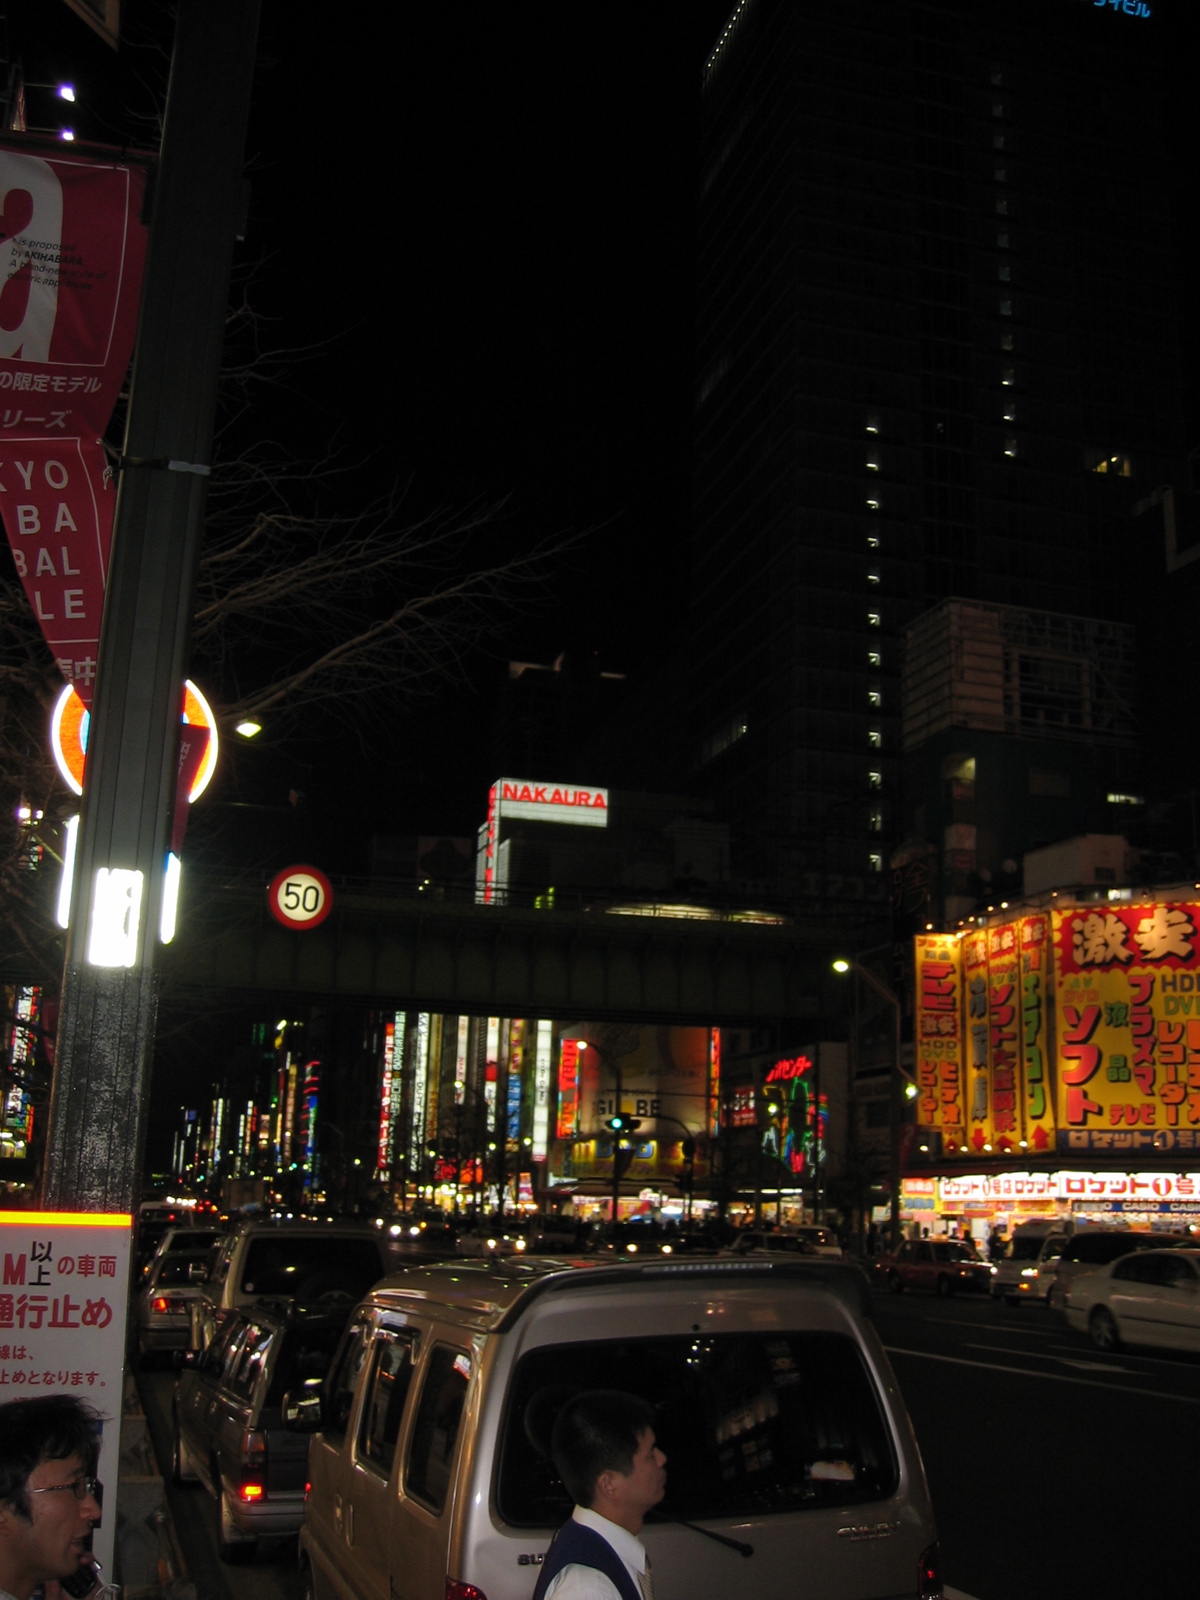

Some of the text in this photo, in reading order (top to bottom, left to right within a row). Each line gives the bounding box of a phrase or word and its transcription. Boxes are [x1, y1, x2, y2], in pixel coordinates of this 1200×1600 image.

[9, 259, 17, 267] A
[11, 248, 83, 265] by AKIHABARA
[0, 409, 72, 429] リーズ
[502, 783, 608, 810] NAKAURA
[284, 882, 320, 913] 50
[1071, 907, 1196, 967] 激安
[1161, 974, 1200, 993] HD
[1064, 989, 1099, 1004] DVD
[1164, 996, 1200, 1016] DV
[1129, 974, 1155, 1096] プラズマ
[920, 1041, 957, 1050] HDD
[1061, 1005, 1102, 1126] ソフト
[1158, 1020, 1186, 1125] レコーダー
[1109, 1104, 1156, 1126] テレビ
[1122, 1202, 1160, 1212] CASIO
[1169, 1202, 1200, 1213] CASI
